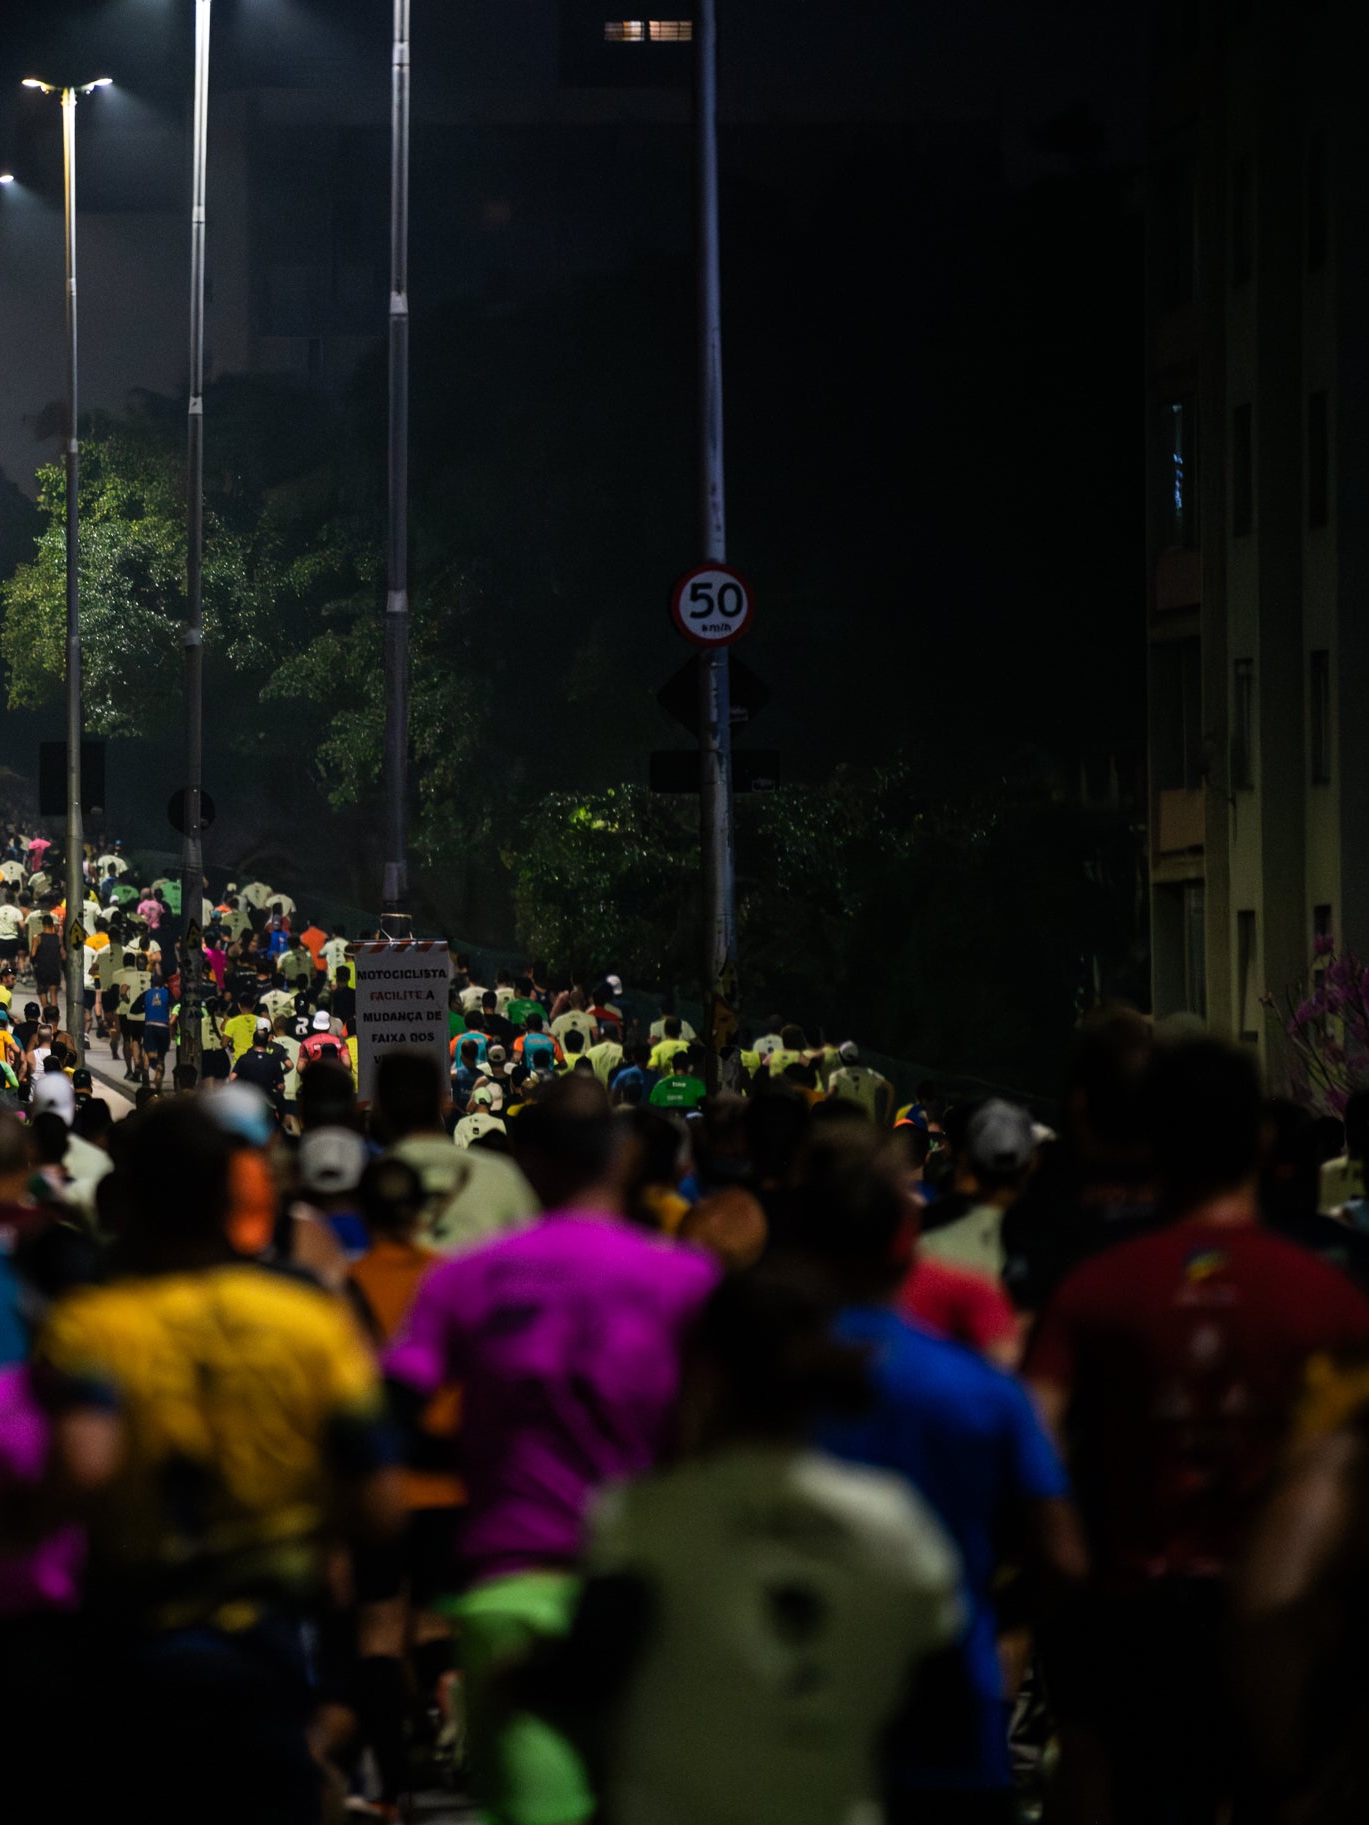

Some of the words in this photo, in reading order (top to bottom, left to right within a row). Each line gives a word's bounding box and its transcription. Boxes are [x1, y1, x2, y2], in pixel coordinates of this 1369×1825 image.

[690, 583, 743, 619] 50
[702, 623, 732, 632] km/h
[357, 969, 447, 980] MOTOCICLISTA
[370, 991, 423, 1001] FACILITE
[426, 990, 435, 1001] A
[363, 1011, 423, 1022] MUDANÇA
[426, 1010, 442, 1021] DE
[371, 1033, 406, 1043] FAIXA
[410, 1032, 435, 1042] DOS
